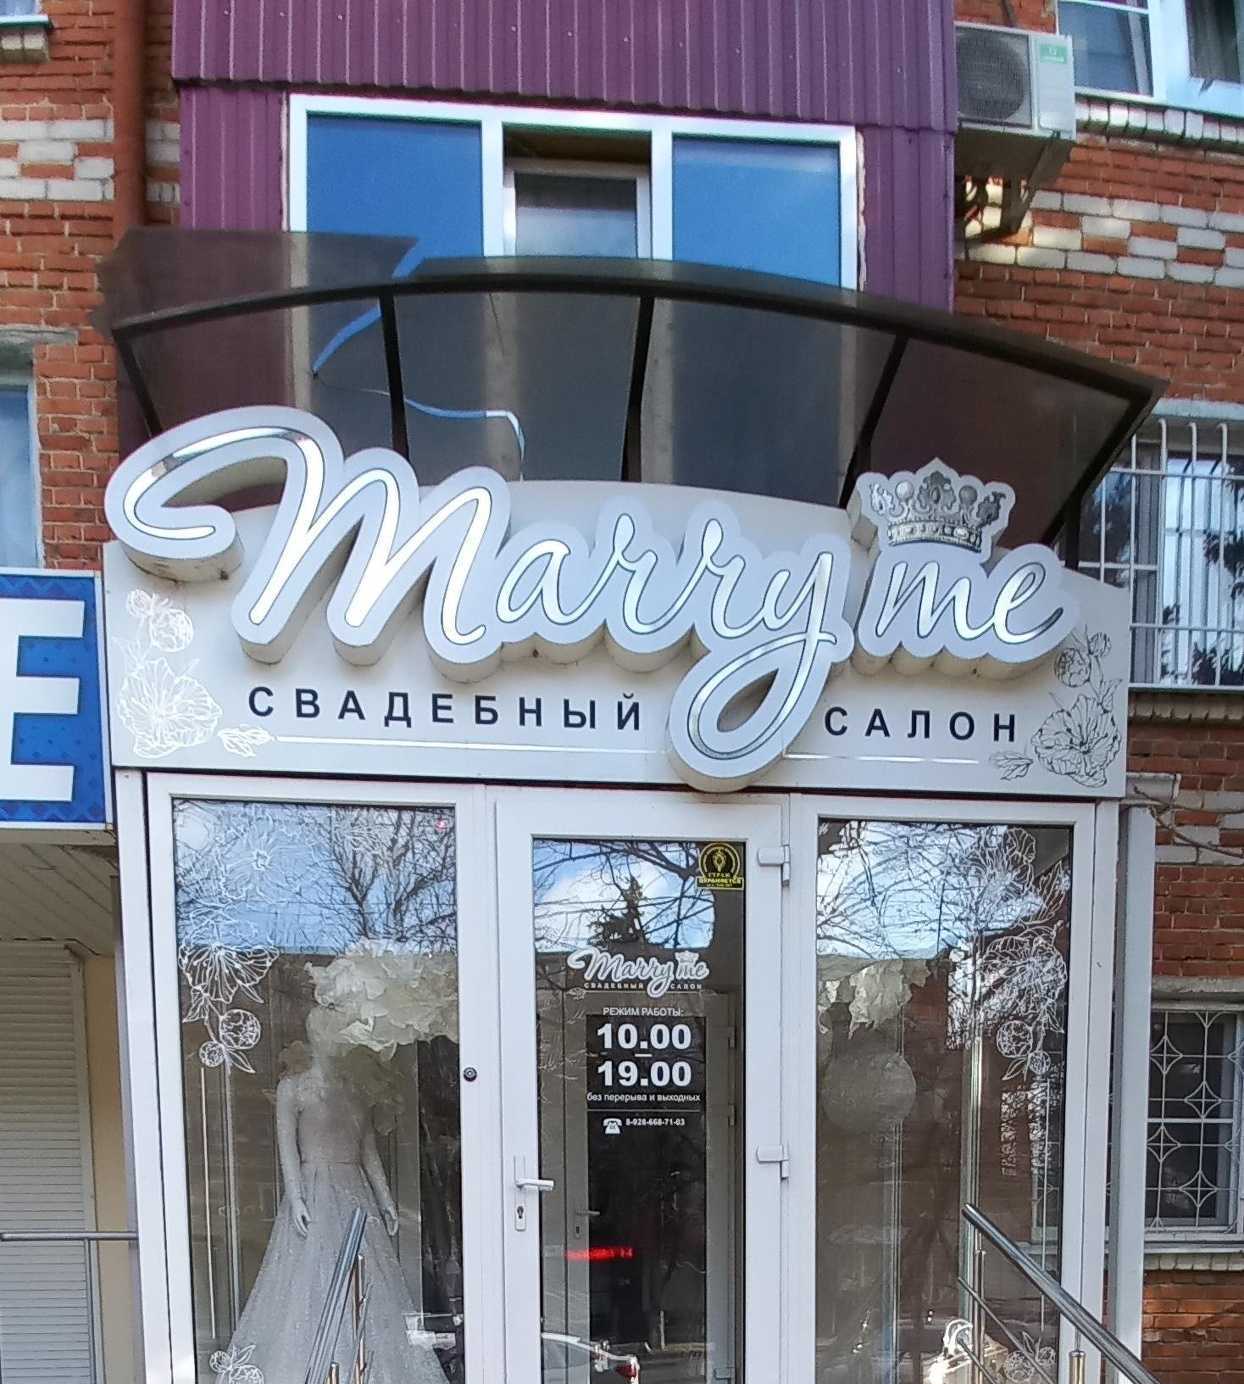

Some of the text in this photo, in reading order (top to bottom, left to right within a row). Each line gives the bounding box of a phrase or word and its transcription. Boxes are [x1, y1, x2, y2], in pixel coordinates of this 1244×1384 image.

[120, 424, 1065, 761] Marry me
[248, 686, 1017, 743] СВАДЕБНЫЙ САЛОН
[566, 946, 710, 998] Marry me
[583, 982, 644, 990] СВАДЕБНЫЙ
[602, 1007, 685, 1017] РЕЖИМ РАБОТЫ:
[596, 1023, 692, 1050] 10.00
[597, 1060, 692, 1087] 19.00
[586, 1091, 701, 1103] без перерыва и выходных
